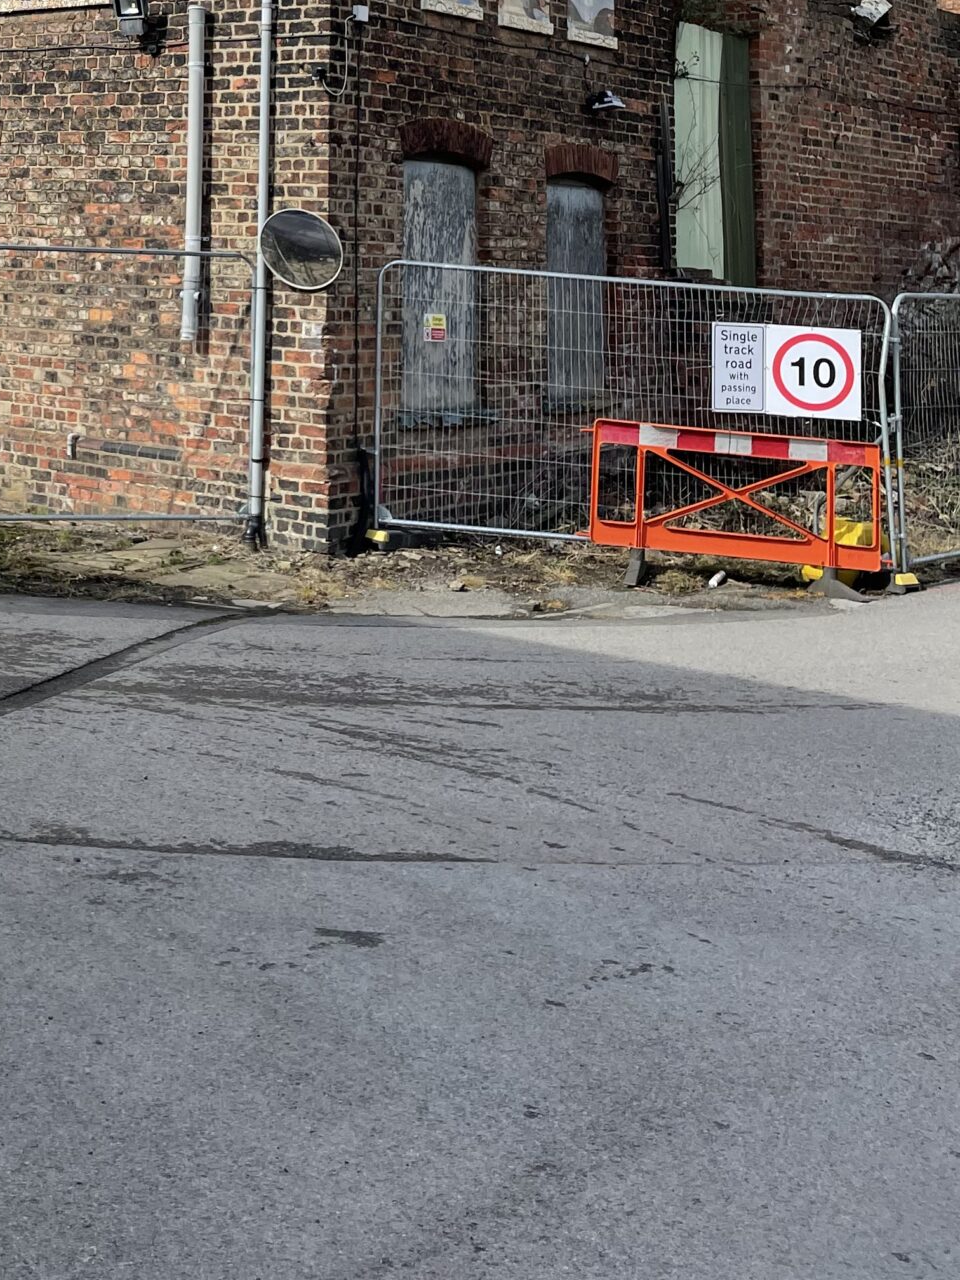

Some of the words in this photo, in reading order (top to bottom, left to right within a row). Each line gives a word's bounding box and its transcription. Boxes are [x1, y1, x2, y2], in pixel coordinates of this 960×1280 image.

[721, 330, 758, 343] Single
[724, 343, 754, 356] track
[725, 358, 752, 369] road
[729, 371, 749, 381] with
[791, 356, 836, 389] 10
[721, 384, 756, 394] passing
[725, 396, 752, 406] place
